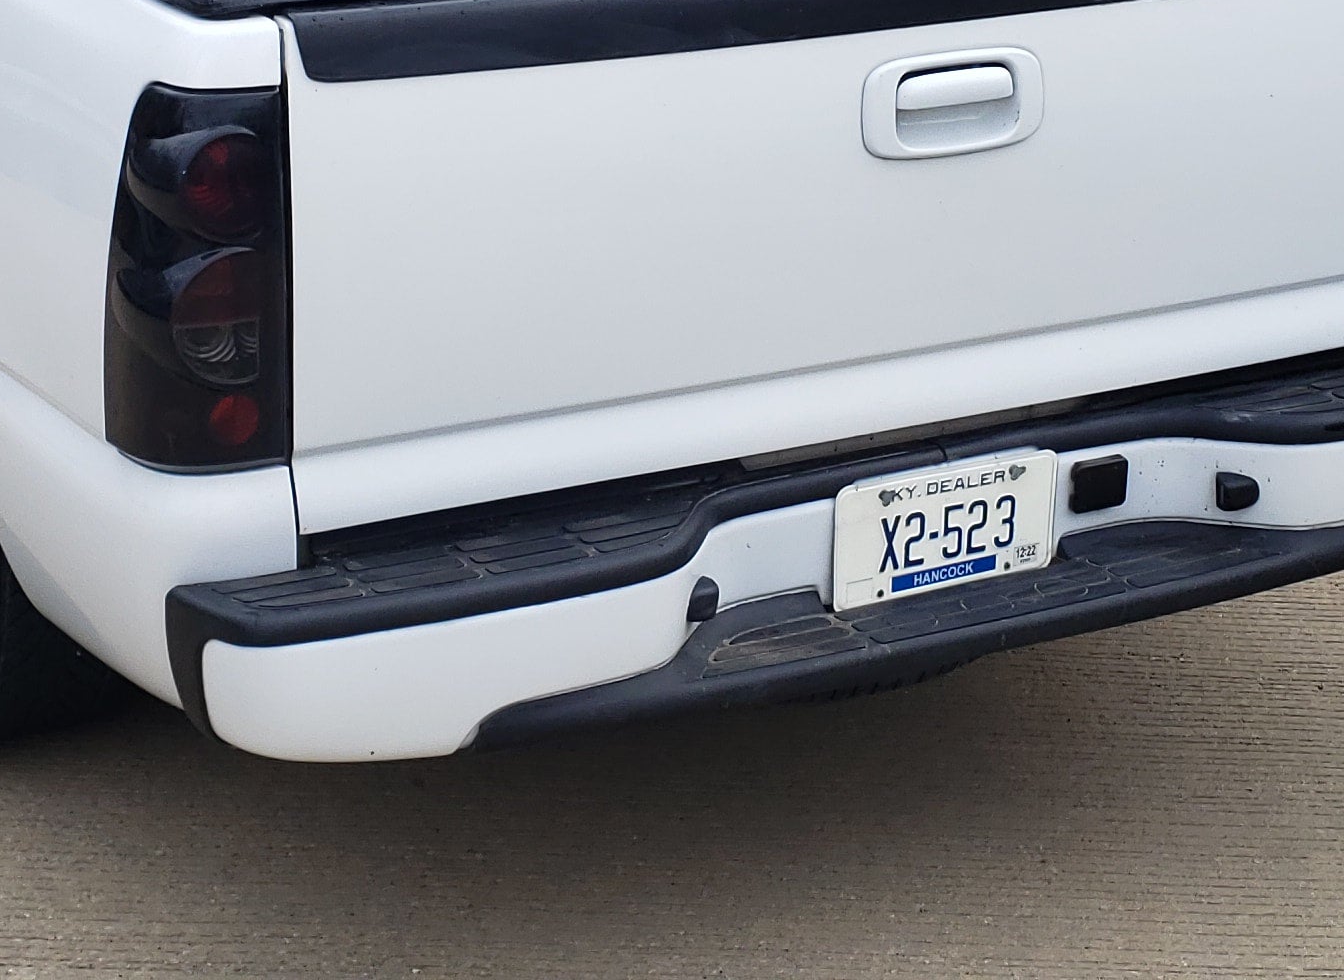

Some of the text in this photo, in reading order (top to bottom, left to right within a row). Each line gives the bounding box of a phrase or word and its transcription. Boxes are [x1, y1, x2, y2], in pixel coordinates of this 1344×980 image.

[926, 469, 1006, 497] DEALER
[878, 494, 1016, 573] X2-523
[913, 564, 975, 587] HANCOCK
